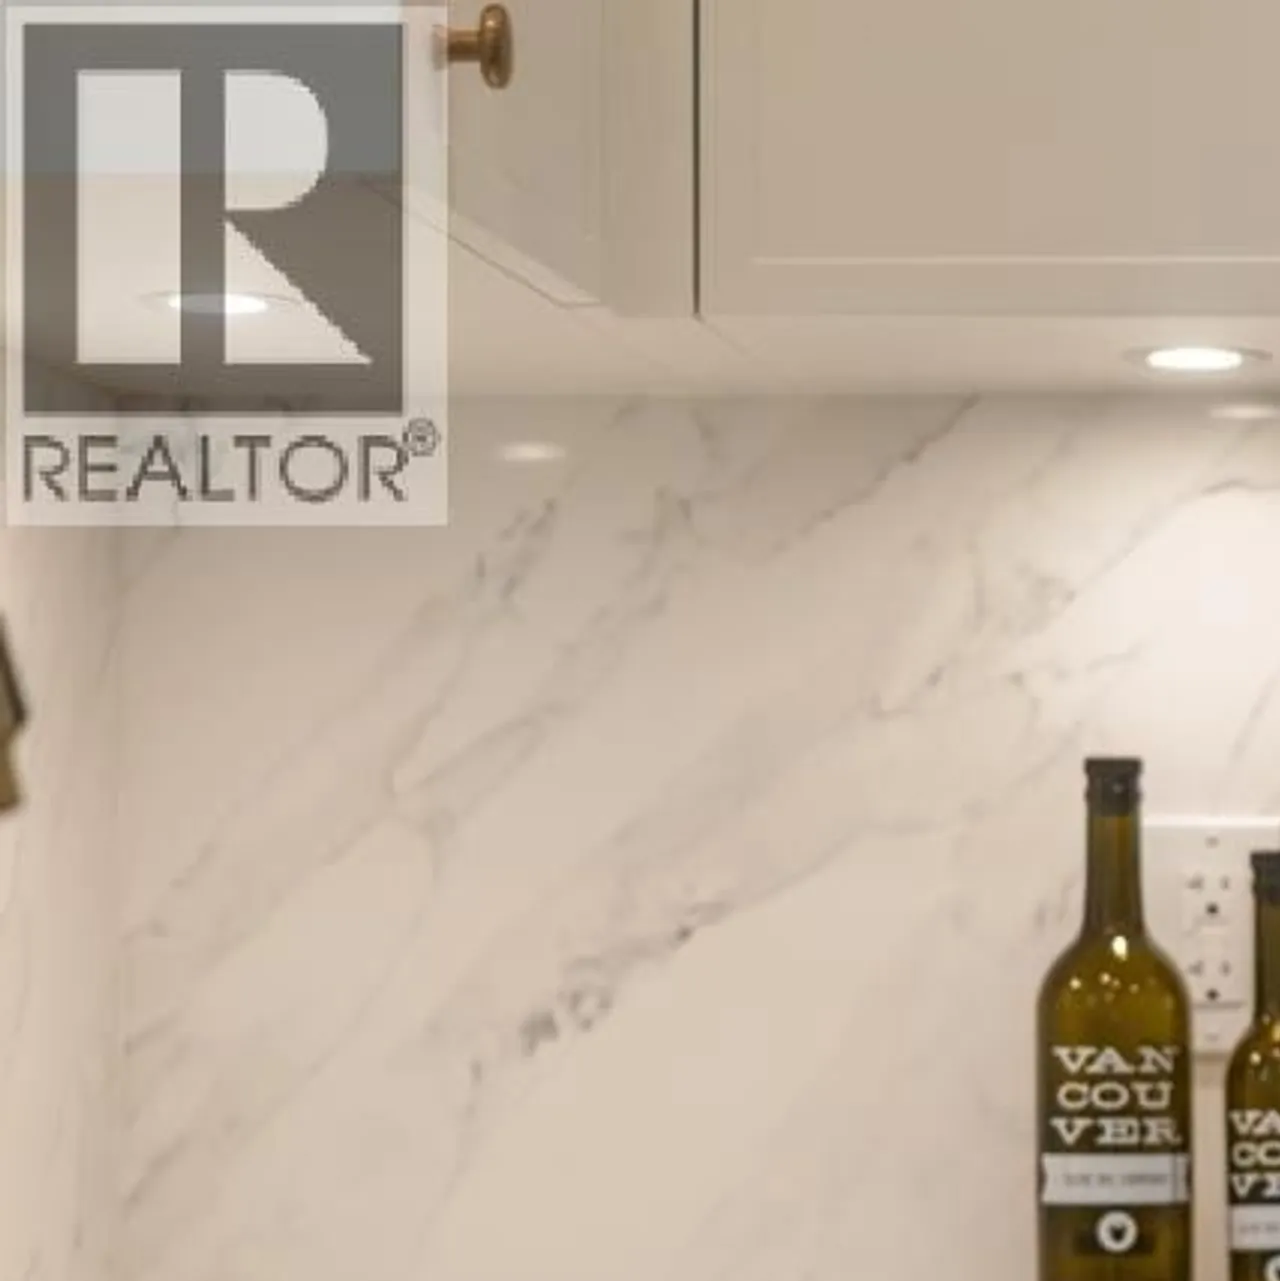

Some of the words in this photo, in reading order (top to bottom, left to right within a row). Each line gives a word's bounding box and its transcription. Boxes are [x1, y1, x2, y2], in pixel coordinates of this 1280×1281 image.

[1053, 1045, 1179, 1074] VAN
[1056, 1081, 1175, 1110] COU
[1049, 1116, 1183, 1145] VER
